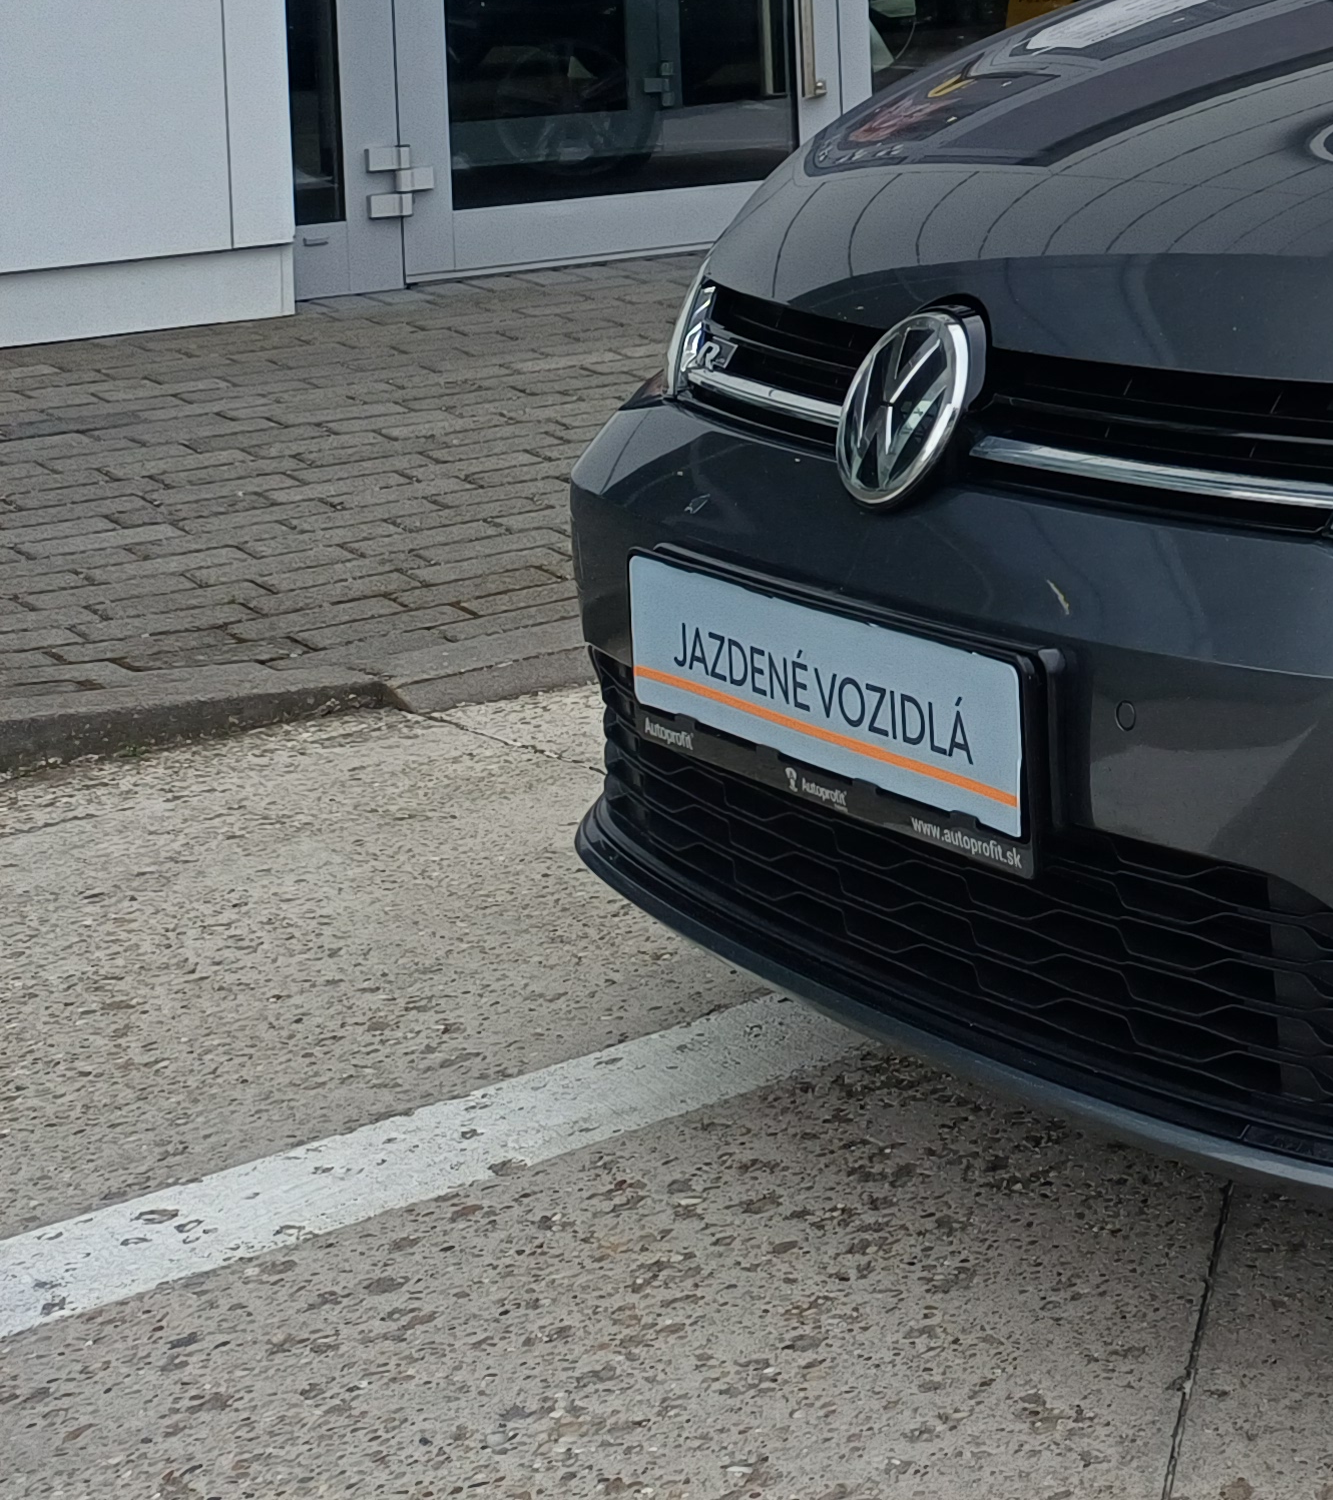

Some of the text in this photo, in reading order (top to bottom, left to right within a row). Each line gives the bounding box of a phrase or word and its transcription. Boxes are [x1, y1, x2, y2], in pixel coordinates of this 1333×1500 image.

[674, 622, 975, 765] JAZDENÉ VOZIDLÁ
[644, 716, 694, 750] Autoprofit
[802, 777, 848, 806] Autoprofit
[911, 816, 1023, 869] www.autoprofit.sk
